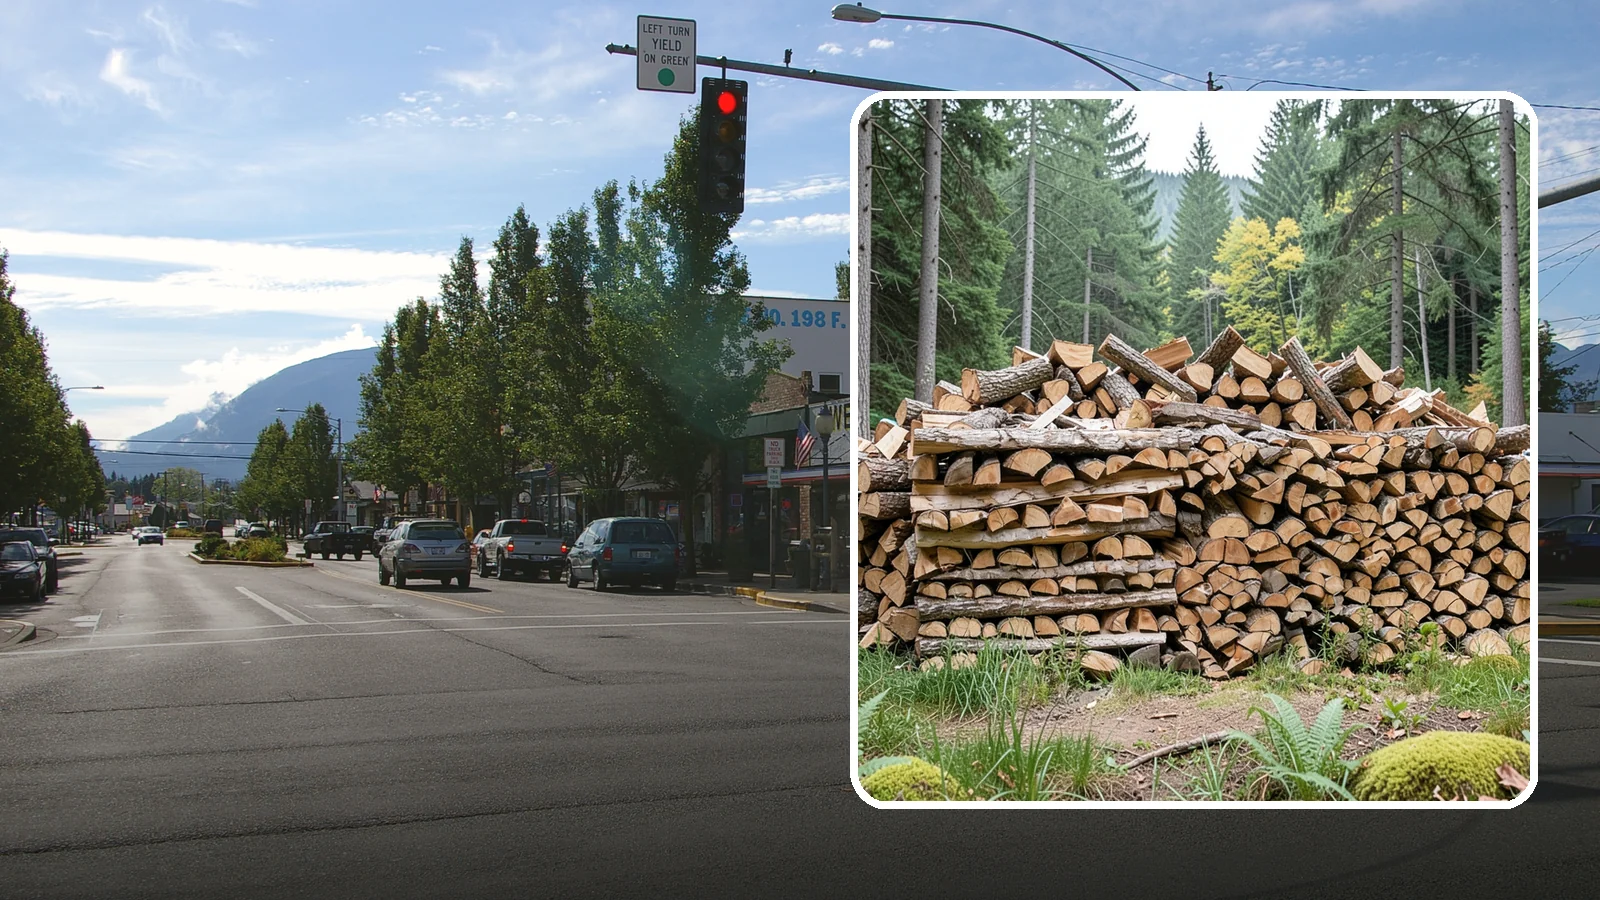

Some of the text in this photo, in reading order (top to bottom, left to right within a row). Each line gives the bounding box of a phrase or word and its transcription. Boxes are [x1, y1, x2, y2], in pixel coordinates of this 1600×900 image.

[643, 24, 690, 36] LEFT TURN
[652, 38, 682, 52] YIELD
[644, 53, 689, 66] ON GREEN
[791, 310, 826, 328] 198
[831, 312, 847, 328] F.
